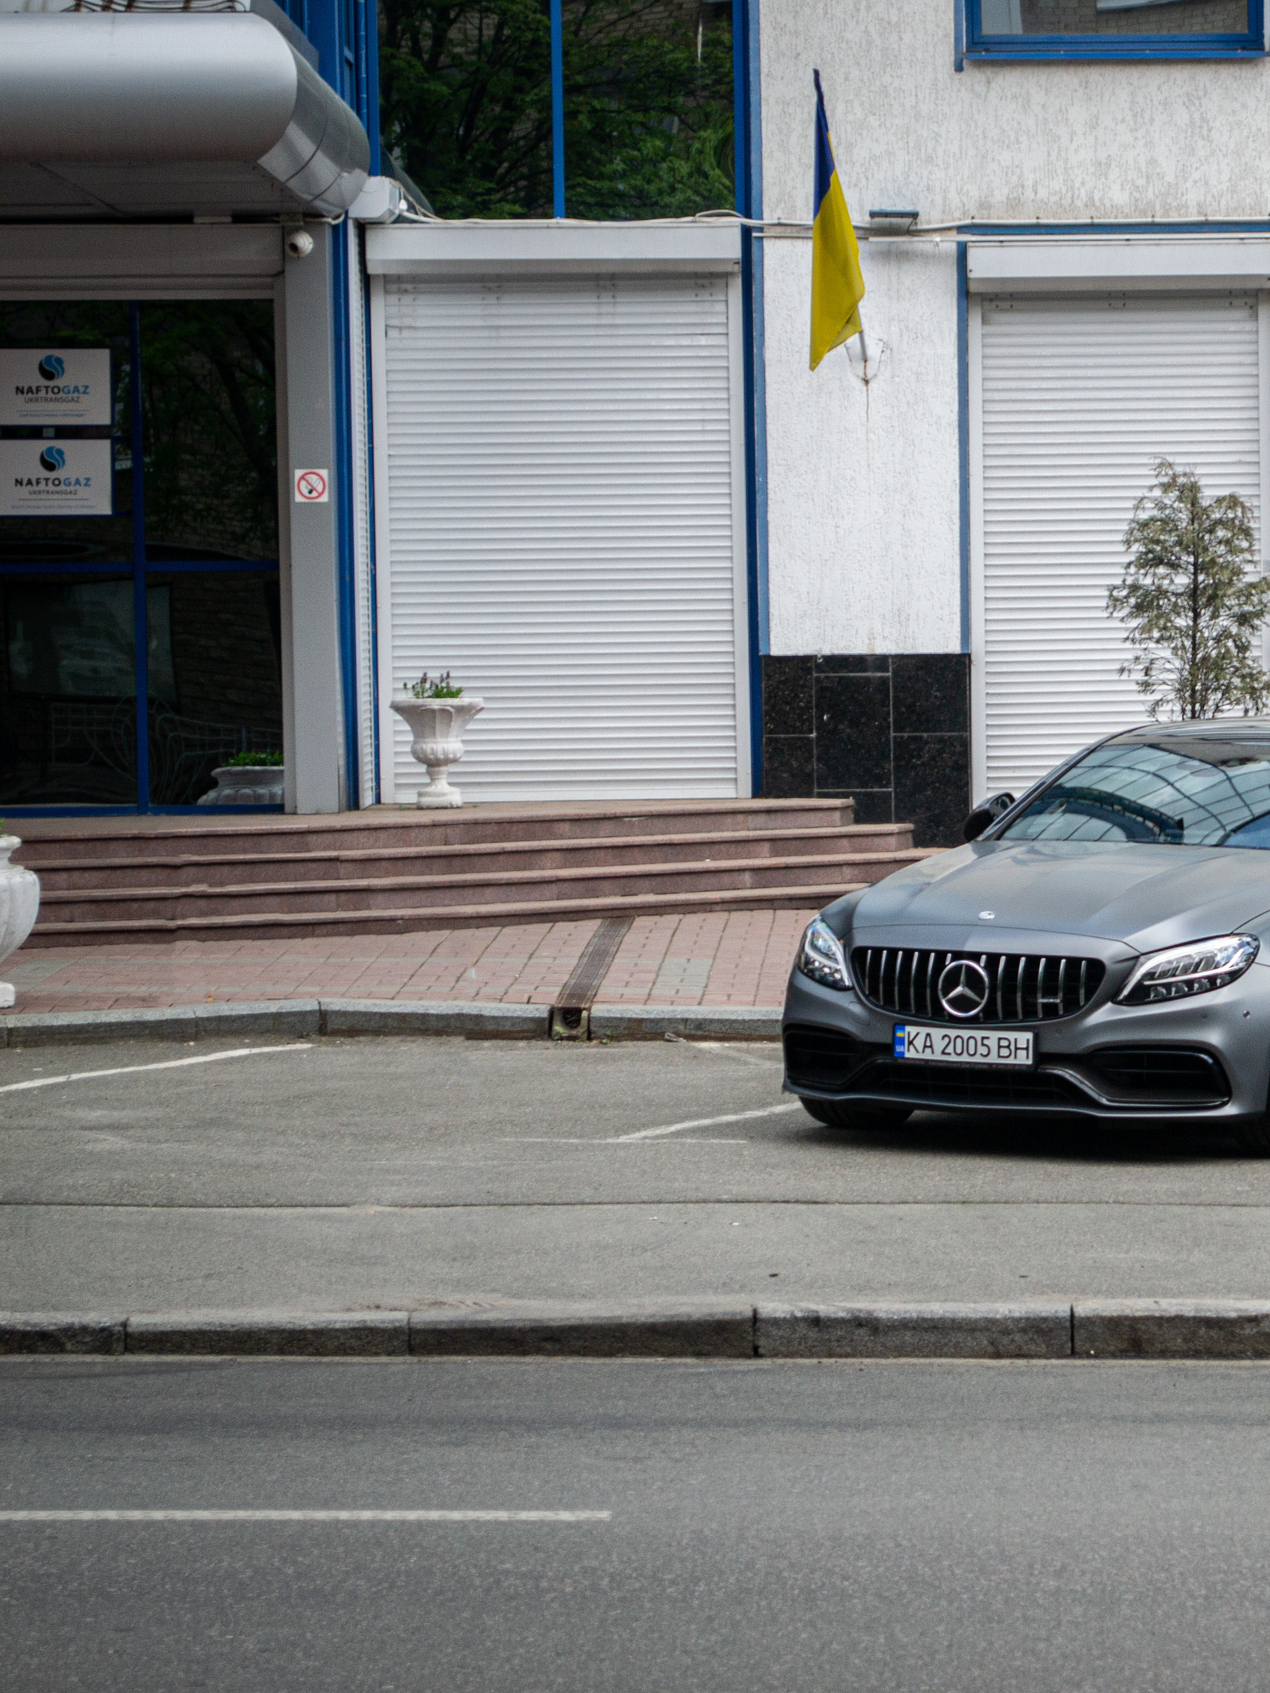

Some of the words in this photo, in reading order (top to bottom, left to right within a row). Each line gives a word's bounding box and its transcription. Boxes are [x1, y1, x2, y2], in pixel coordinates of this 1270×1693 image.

[15, 385, 90, 395] NAFTOGAZ
[24, 396, 80, 404] UKRTRANSGAZ
[14, 477, 91, 487] NAFTOGAZ
[906, 1031, 935, 1055] KA
[940, 1033, 991, 1058] 2005
[997, 1036, 1030, 1060] BH
